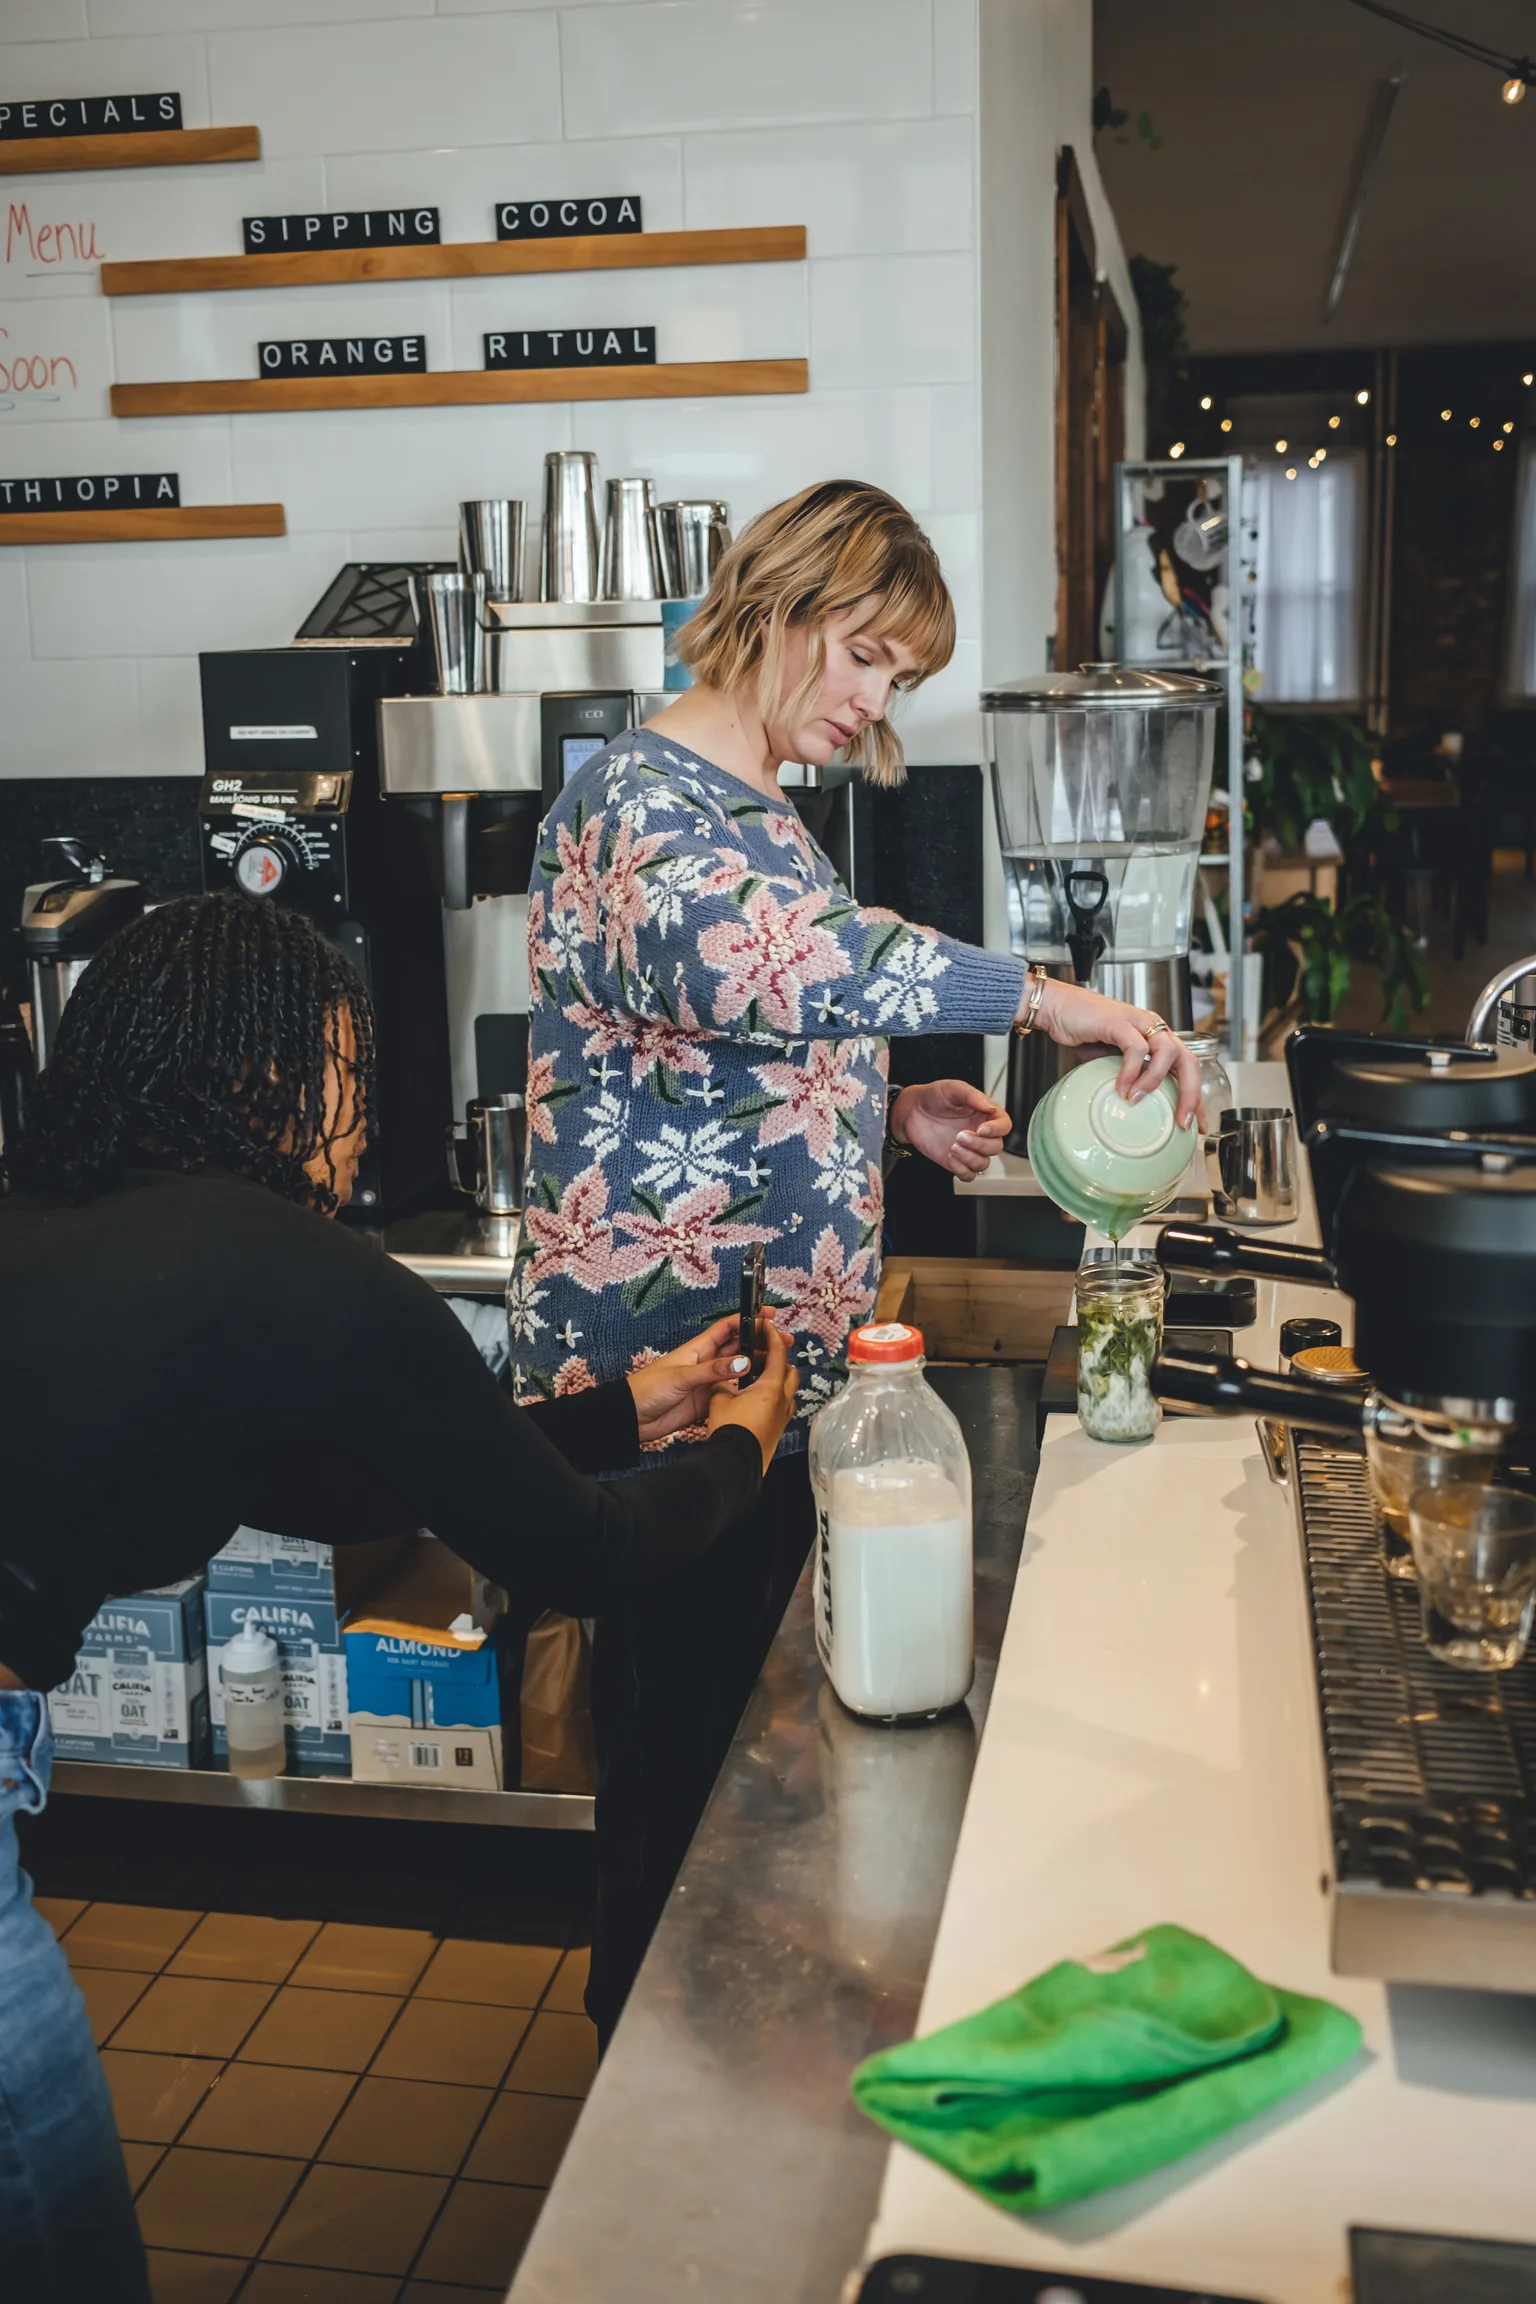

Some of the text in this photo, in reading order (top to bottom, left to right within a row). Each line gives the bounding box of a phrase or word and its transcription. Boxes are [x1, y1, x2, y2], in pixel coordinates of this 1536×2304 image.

[0, 96, 175, 129] PECIALS
[249, 199, 637, 243] SIPPING COCOA
[6, 203, 105, 264] Menu
[263, 329, 649, 368] ORANGE RITUAL
[0, 477, 174, 504] THIOPIA
[211, 779, 243, 792] GH2
[262, 794, 280, 804] USA
[231, 1606, 315, 1631] CALIFIA
[87, 1632, 132, 1644] FARMS
[254, 1624, 297, 1636] ARMS
[376, 1637, 462, 1658] ALMOND
[281, 1673, 316, 1685] ALIFIA
[121, 1703, 147, 1719] OAT
[284, 1695, 310, 1710] OAT
